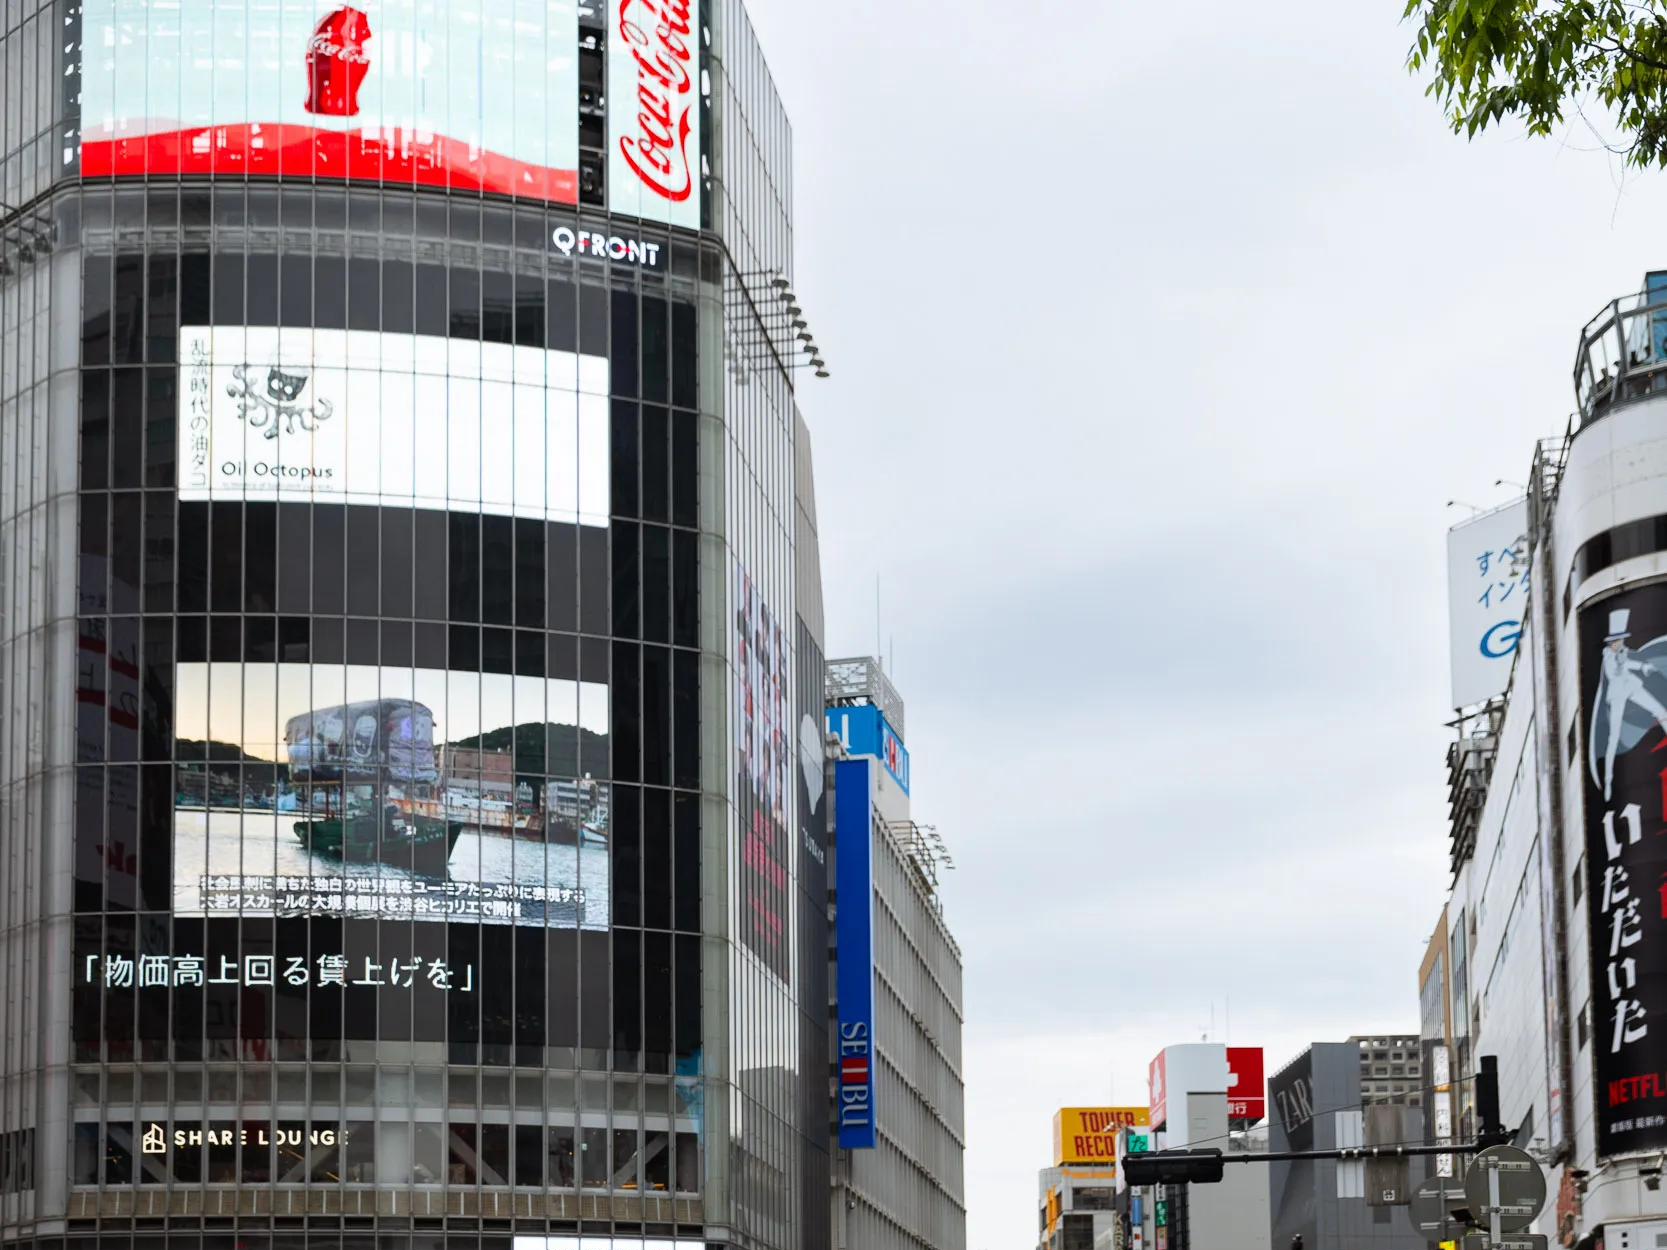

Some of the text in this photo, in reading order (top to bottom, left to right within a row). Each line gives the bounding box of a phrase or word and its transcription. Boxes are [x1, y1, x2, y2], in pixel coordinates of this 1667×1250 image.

[552, 226, 660, 266] QFRONT
[221, 461, 333, 481] Oil Octopus
[1601, 802, 1649, 1053] いただいた
[86, 953, 474, 992] 「物価高上回る賃上げを」
[841, 1021, 869, 1127] SEIBU
[1608, 1073, 1667, 1108] NETFL
[174, 1130, 349, 1145] SHARE LOUNGE
[1079, 1111, 1136, 1133] TOWER
[1074, 1136, 1116, 1157] RECO
